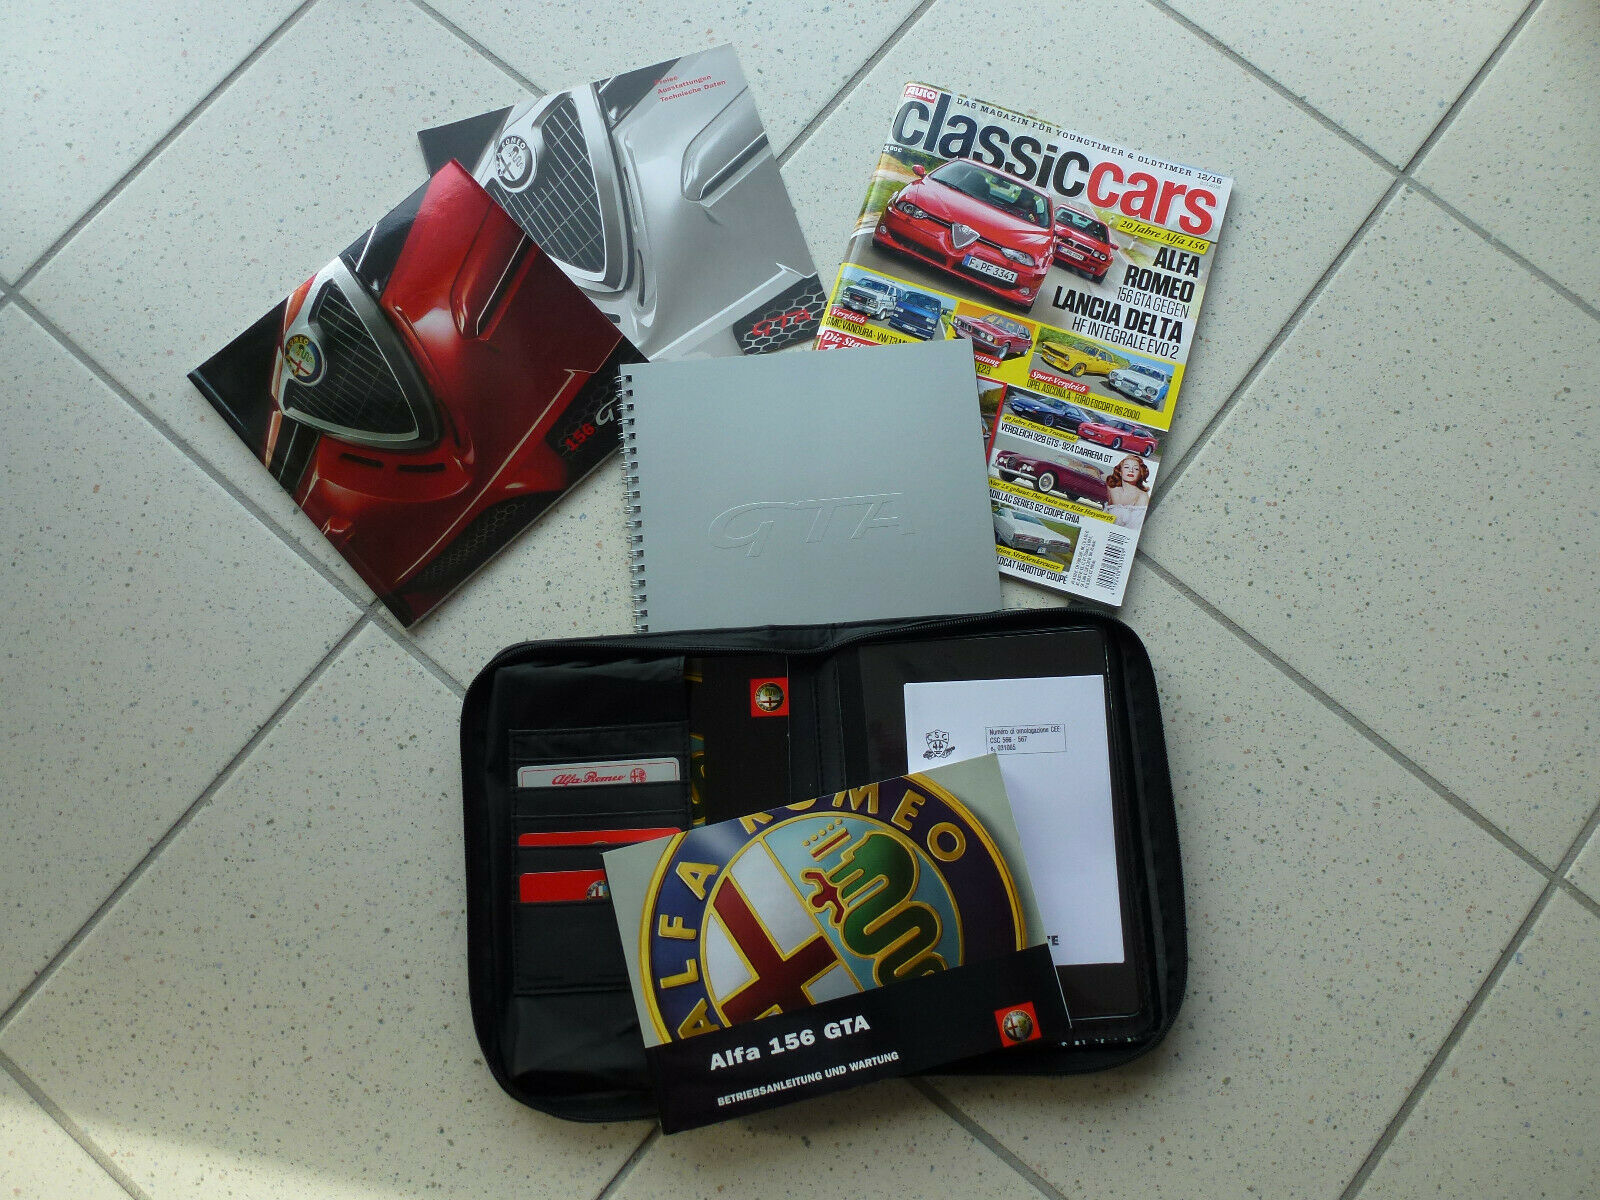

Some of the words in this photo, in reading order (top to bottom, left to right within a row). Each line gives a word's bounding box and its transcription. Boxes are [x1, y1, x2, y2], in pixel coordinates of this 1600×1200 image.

[657, 74, 712, 94] Ausstattungen
[660, 87, 701, 102] Technische
[703, 80, 726, 90] Daten
[956, 98, 976, 109] DAS
[980, 105, 1029, 126] MAGAZIN
[1031, 121, 1052, 134] FÜR
[1056, 130, 1124, 157] YOUNGTIMER
[1127, 152, 1134, 160] &
[1138, 155, 1192, 177] OLDTIMER
[1197, 172, 1223, 185] 12/16
[1120, 220, 1131, 229] 20
[1132, 222, 1161, 239] Jahre
[1162, 232, 1185, 246] Alfa
[1187, 237, 1206, 251] 156
[1152, 246, 1200, 278] ALFA
[1123, 264, 1196, 304] ROMEO
[832, 307, 865, 324] Vergleich
[1052, 285, 1122, 327] LANCIA
[1124, 307, 1184, 344] DELTA
[1117, 286, 1134, 304] 156
[1134, 290, 1152, 309] GTA
[1153, 296, 1190, 320] GEGEN
[752, 308, 812, 336] GTA
[824, 331, 842, 343] Die
[842, 323, 873, 338] VANDURA
[877, 331, 889, 343] VW
[1071, 316, 1088, 333] HF
[1088, 320, 1149, 351] INTEGRALE
[1149, 338, 1168, 357] EVO
[1170, 345, 1180, 360] 2
[974, 354, 1000, 368] ratung
[1030, 370, 1086, 393] Sport-Vergleich
[1041, 382, 1066, 399] ASCONA
[1074, 391, 1090, 405] FORD
[1090, 395, 1114, 413] ESCORT
[1123, 406, 1141, 420] 2000
[565, 422, 596, 452] 156
[1001, 422, 1034, 439] VERGLEICH
[1034, 431, 1047, 444] 928
[1046, 435, 1059, 447] GTS
[1061, 441, 1075, 453] 924
[1074, 445, 1104, 461] CARRERA
[1103, 453, 1113, 464] GT
[989, 488, 1012, 504] ADILLAC
[1012, 495, 1035, 510] SERIES
[1034, 503, 1043, 514] 62
[1064, 513, 1080, 525] GHIA
[708, 492, 920, 558] GTA
[1016, 560, 1046, 577] HARDTOP
[552, 774, 581, 787] Alfa
[584, 771, 625, 783] Romeo
[658, 861, 721, 1040] ALFA
[710, 1046, 760, 1071] Alfa
[768, 1029, 815, 1055] 156
[823, 1014, 871, 1039] GTA
[717, 1071, 823, 1107] BETRIEBSANLEITUNG
[824, 1065, 847, 1078] UND
[849, 1051, 899, 1072] WARTUNG
